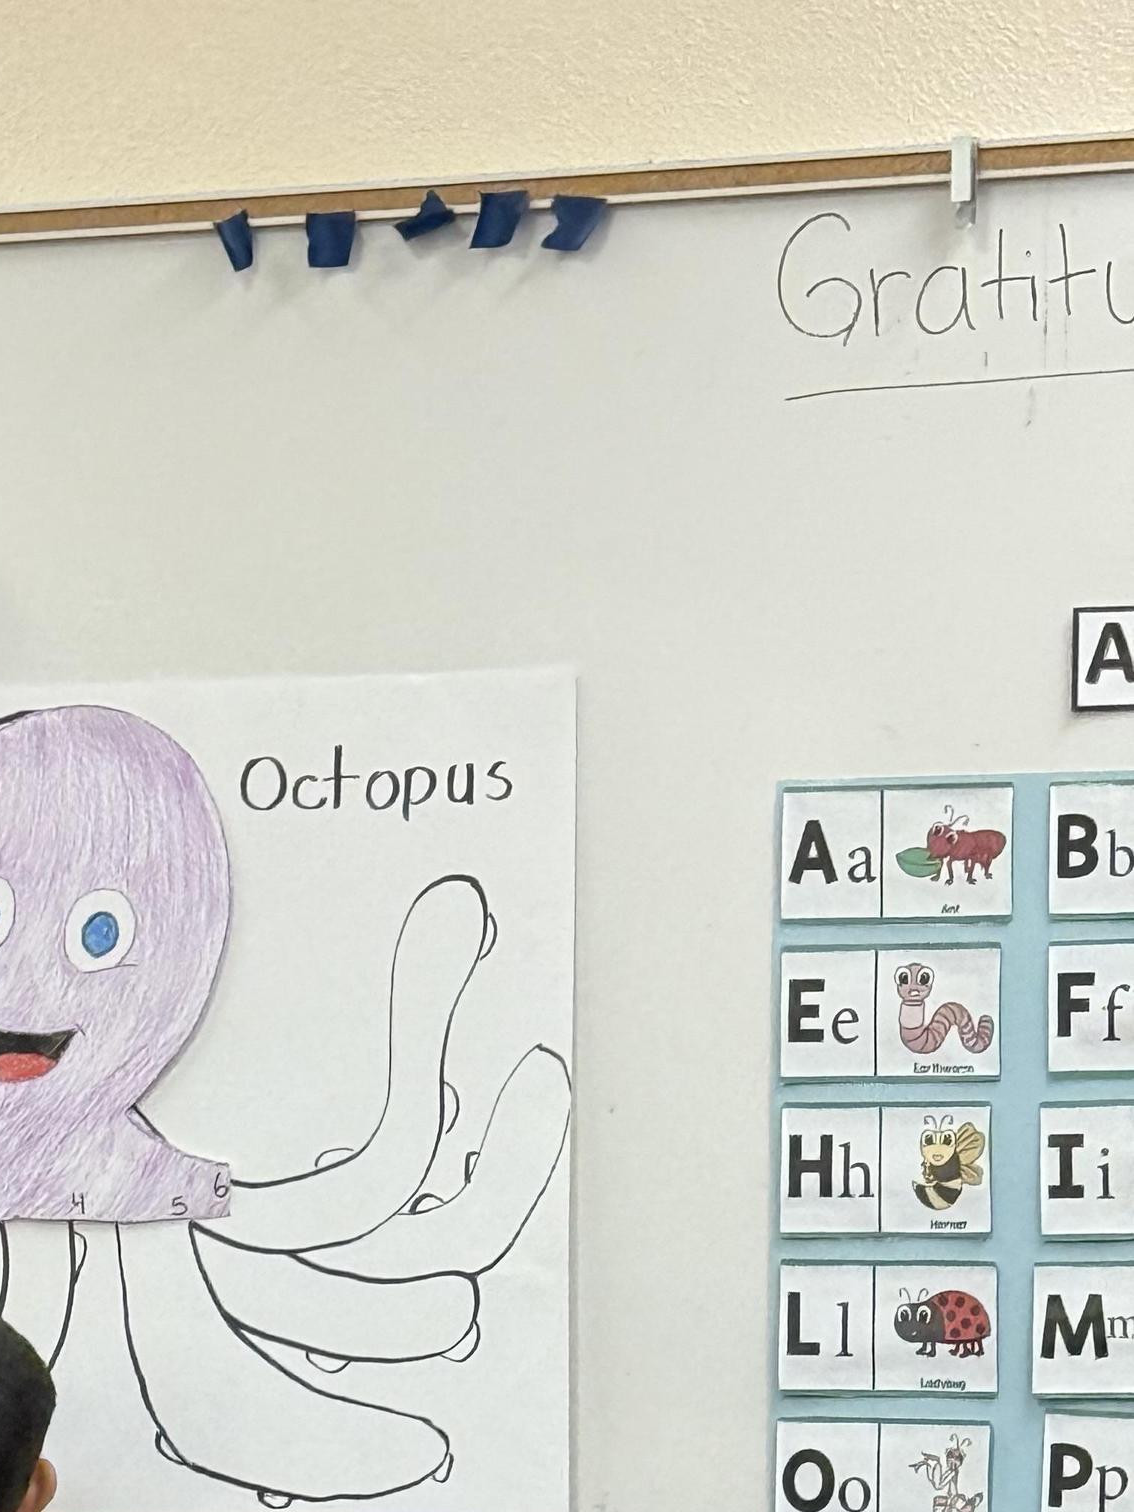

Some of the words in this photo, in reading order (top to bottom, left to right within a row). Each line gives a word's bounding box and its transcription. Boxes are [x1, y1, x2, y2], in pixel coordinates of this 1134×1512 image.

[777, 211, 1134, 347] Gratitu
[239, 744, 514, 822] Octopus
[213, 1172, 228, 1200] 6
[70, 1192, 86, 1216] 4
[170, 1196, 189, 1217] 5
